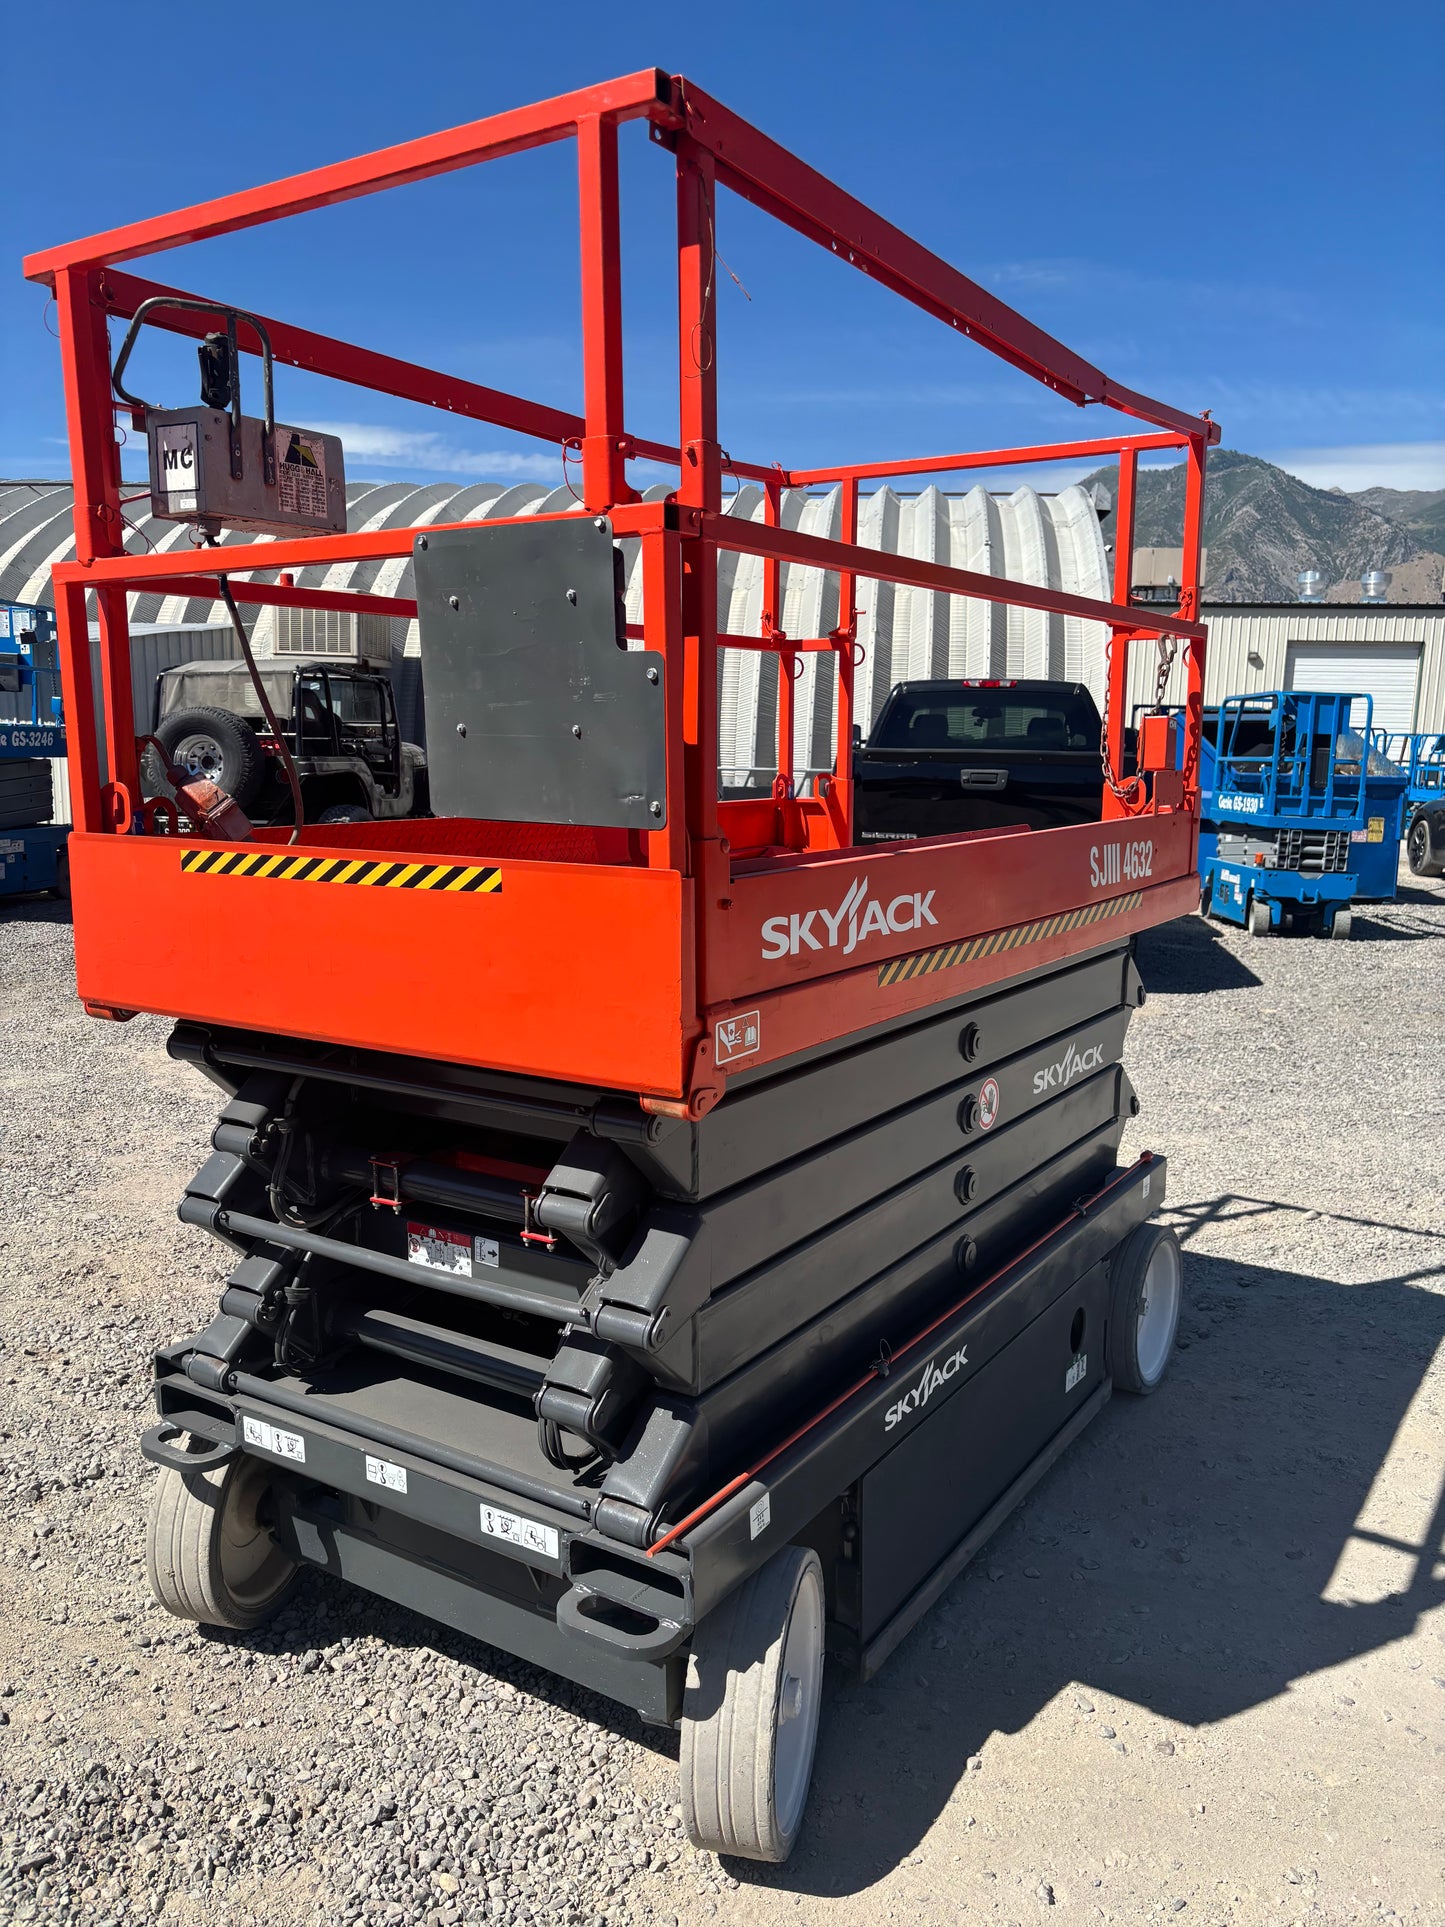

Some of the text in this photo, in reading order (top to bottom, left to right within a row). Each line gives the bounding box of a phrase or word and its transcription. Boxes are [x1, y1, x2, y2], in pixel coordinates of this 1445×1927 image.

[279, 462, 301, 473] HUGG
[306, 467, 323, 477] HALL
[1123, 839, 1153, 880] 4632
[761, 875, 939, 960] SKYJACK
[1033, 1042, 1104, 1095] SKYJACK
[884, 1344, 969, 1432] SKYJACK
